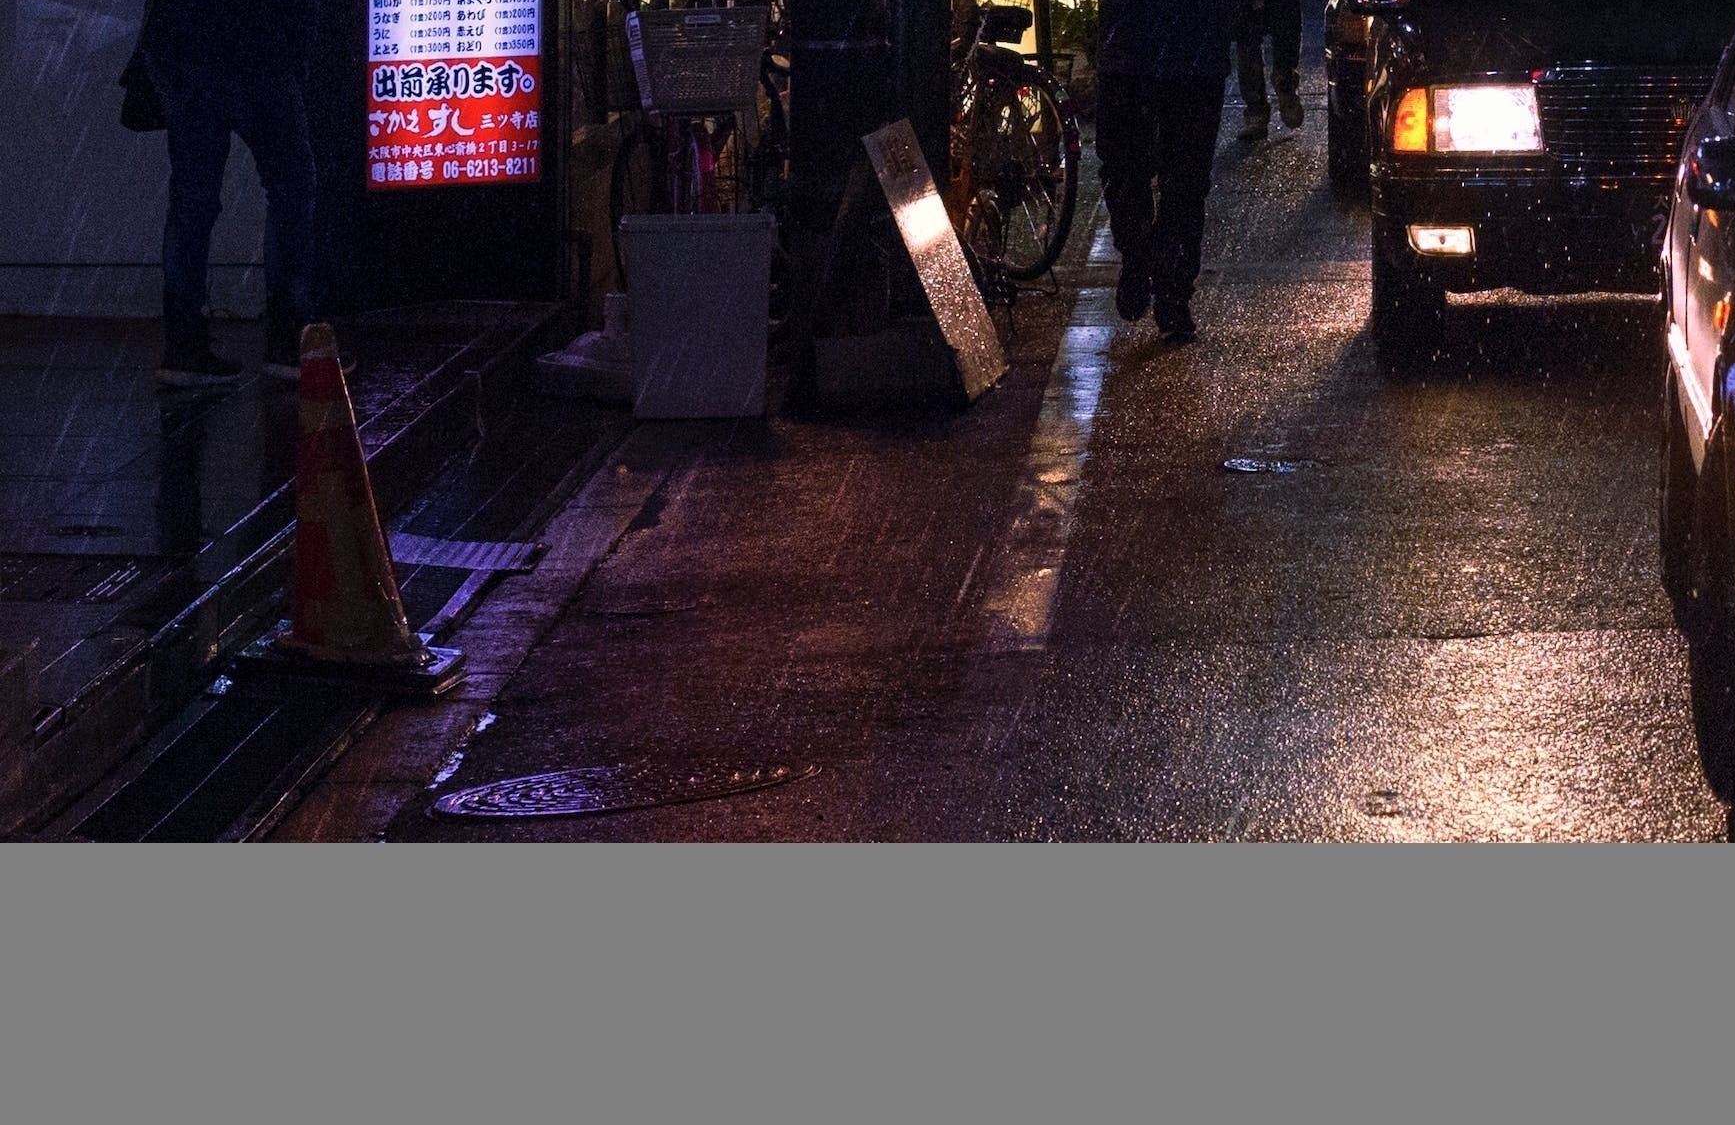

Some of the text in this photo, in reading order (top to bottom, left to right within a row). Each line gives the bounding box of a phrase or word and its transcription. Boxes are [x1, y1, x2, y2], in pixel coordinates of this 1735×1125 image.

[373, 62, 535, 101] 出前承ります。
[480, 110, 538, 131] 三ツ寺店
[371, 156, 536, 182] 電話番号 06-6213-8211
